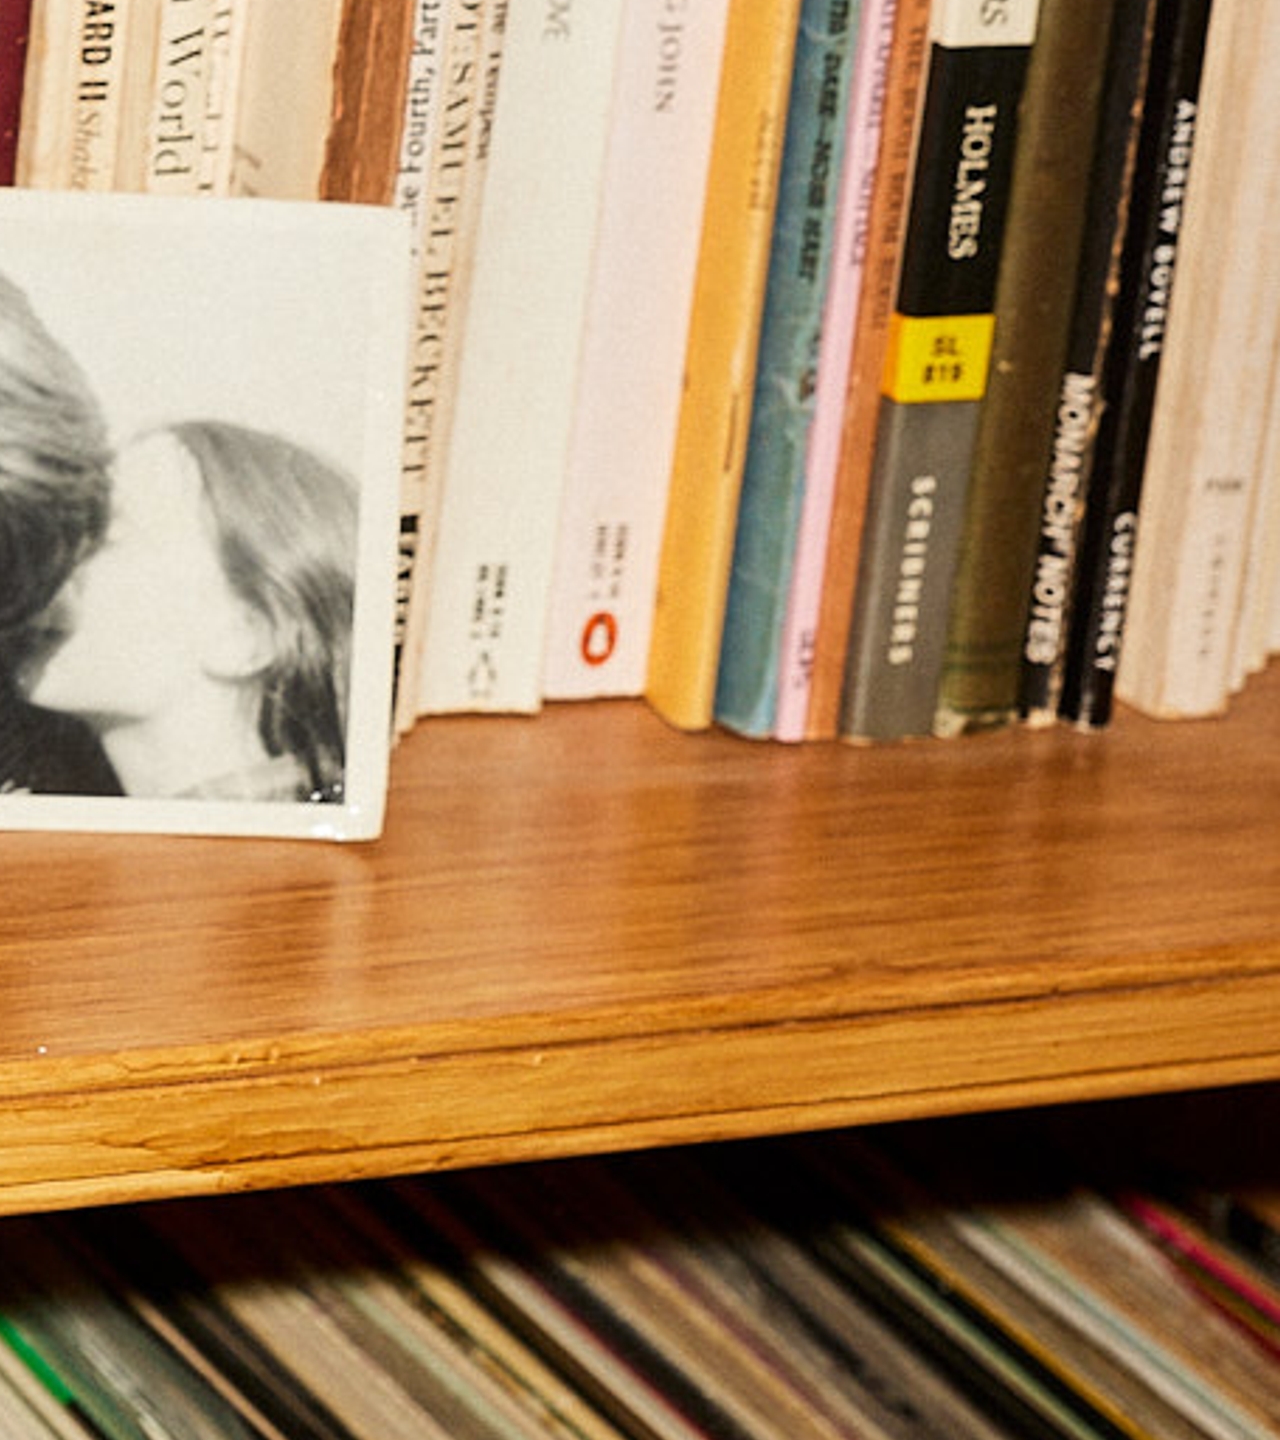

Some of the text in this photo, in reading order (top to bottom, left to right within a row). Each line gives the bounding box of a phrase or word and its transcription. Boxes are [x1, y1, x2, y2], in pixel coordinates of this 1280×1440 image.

[154, 29, 206, 177] World
[653, 24, 683, 113] JOHN
[426, 62, 474, 255] SAMUEL
[947, 105, 997, 259] HOLMES
[1158, 100, 1197, 234] ANDREW
[888, 476, 937, 665] SCRIBNERS
[1025, 554, 1068, 664] NOTES
[1094, 513, 1137, 671] CURRENCY
